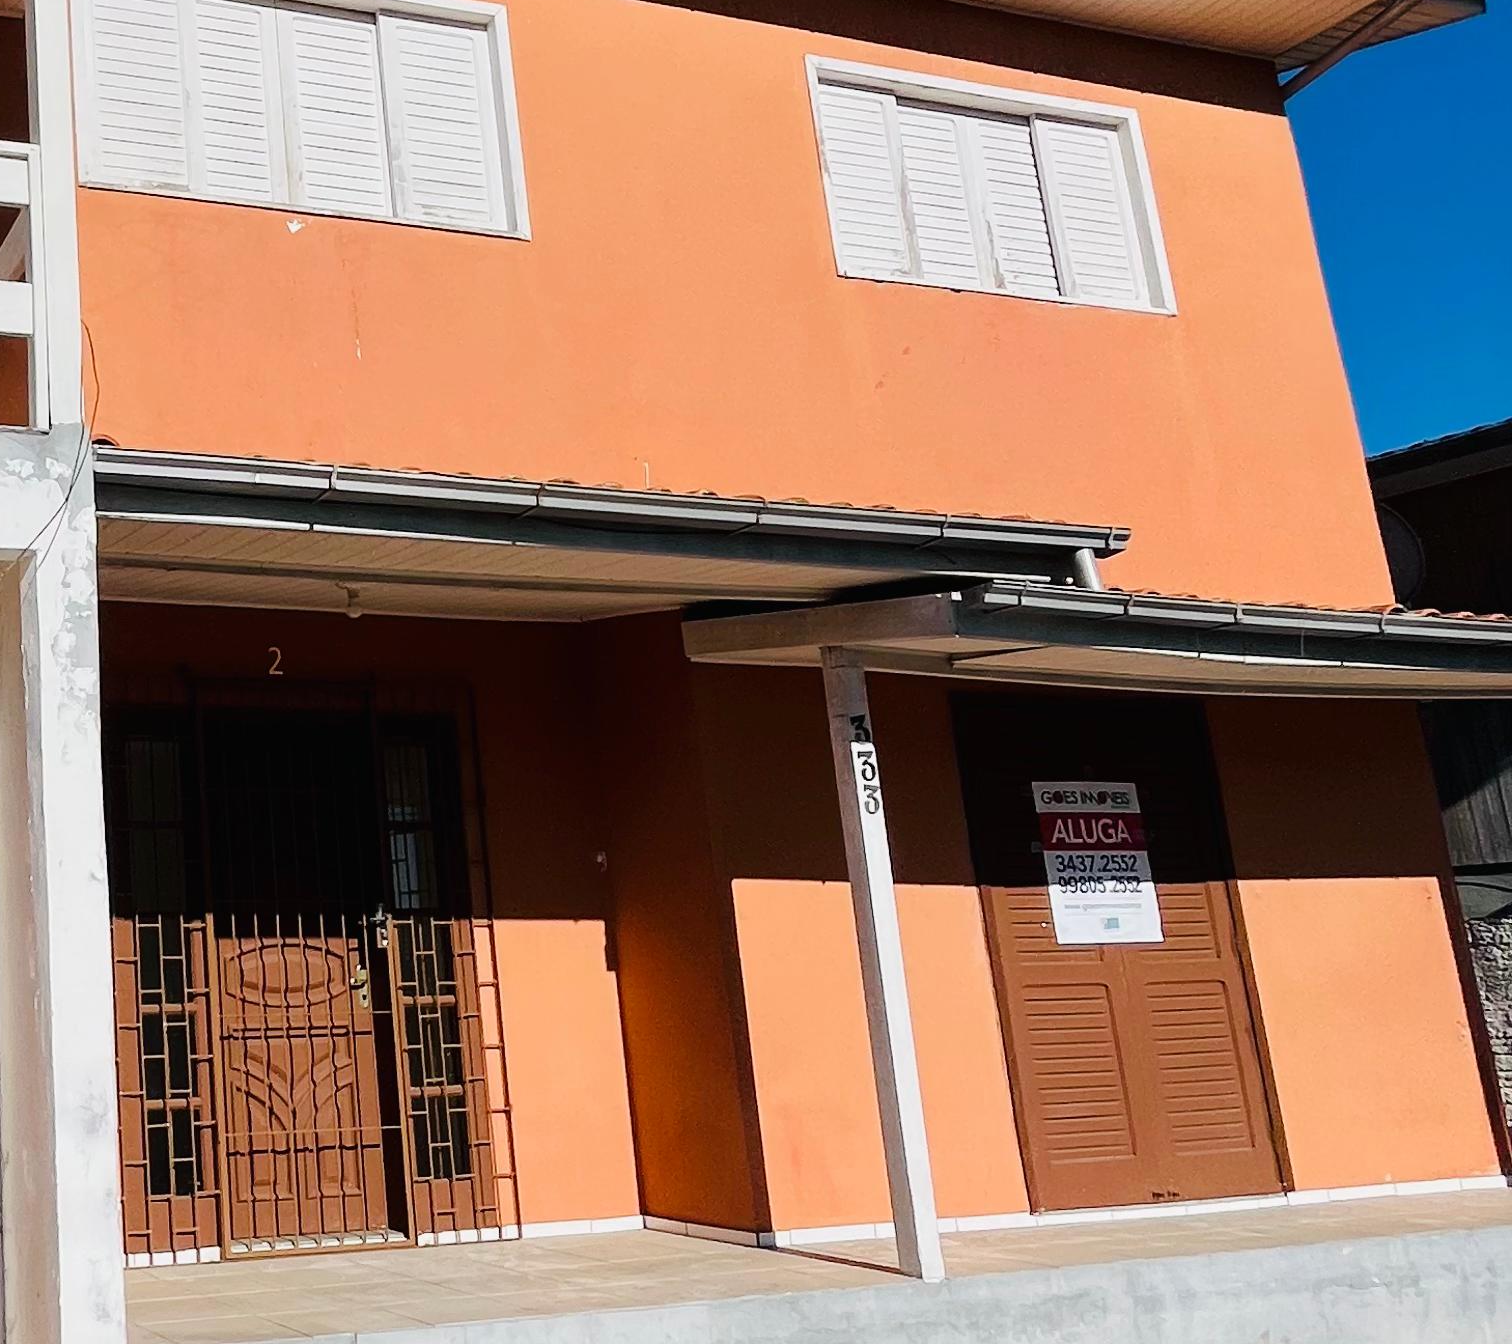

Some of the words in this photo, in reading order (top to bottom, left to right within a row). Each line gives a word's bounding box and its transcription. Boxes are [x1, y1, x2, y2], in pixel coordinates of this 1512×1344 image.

[268, 646, 284, 675] 2
[1041, 790, 1079, 805] GOES
[1051, 818, 1132, 844] ALUGA
[1055, 854, 1138, 873] 3437.2552
[1058, 875, 1143, 894] 99805.2552
